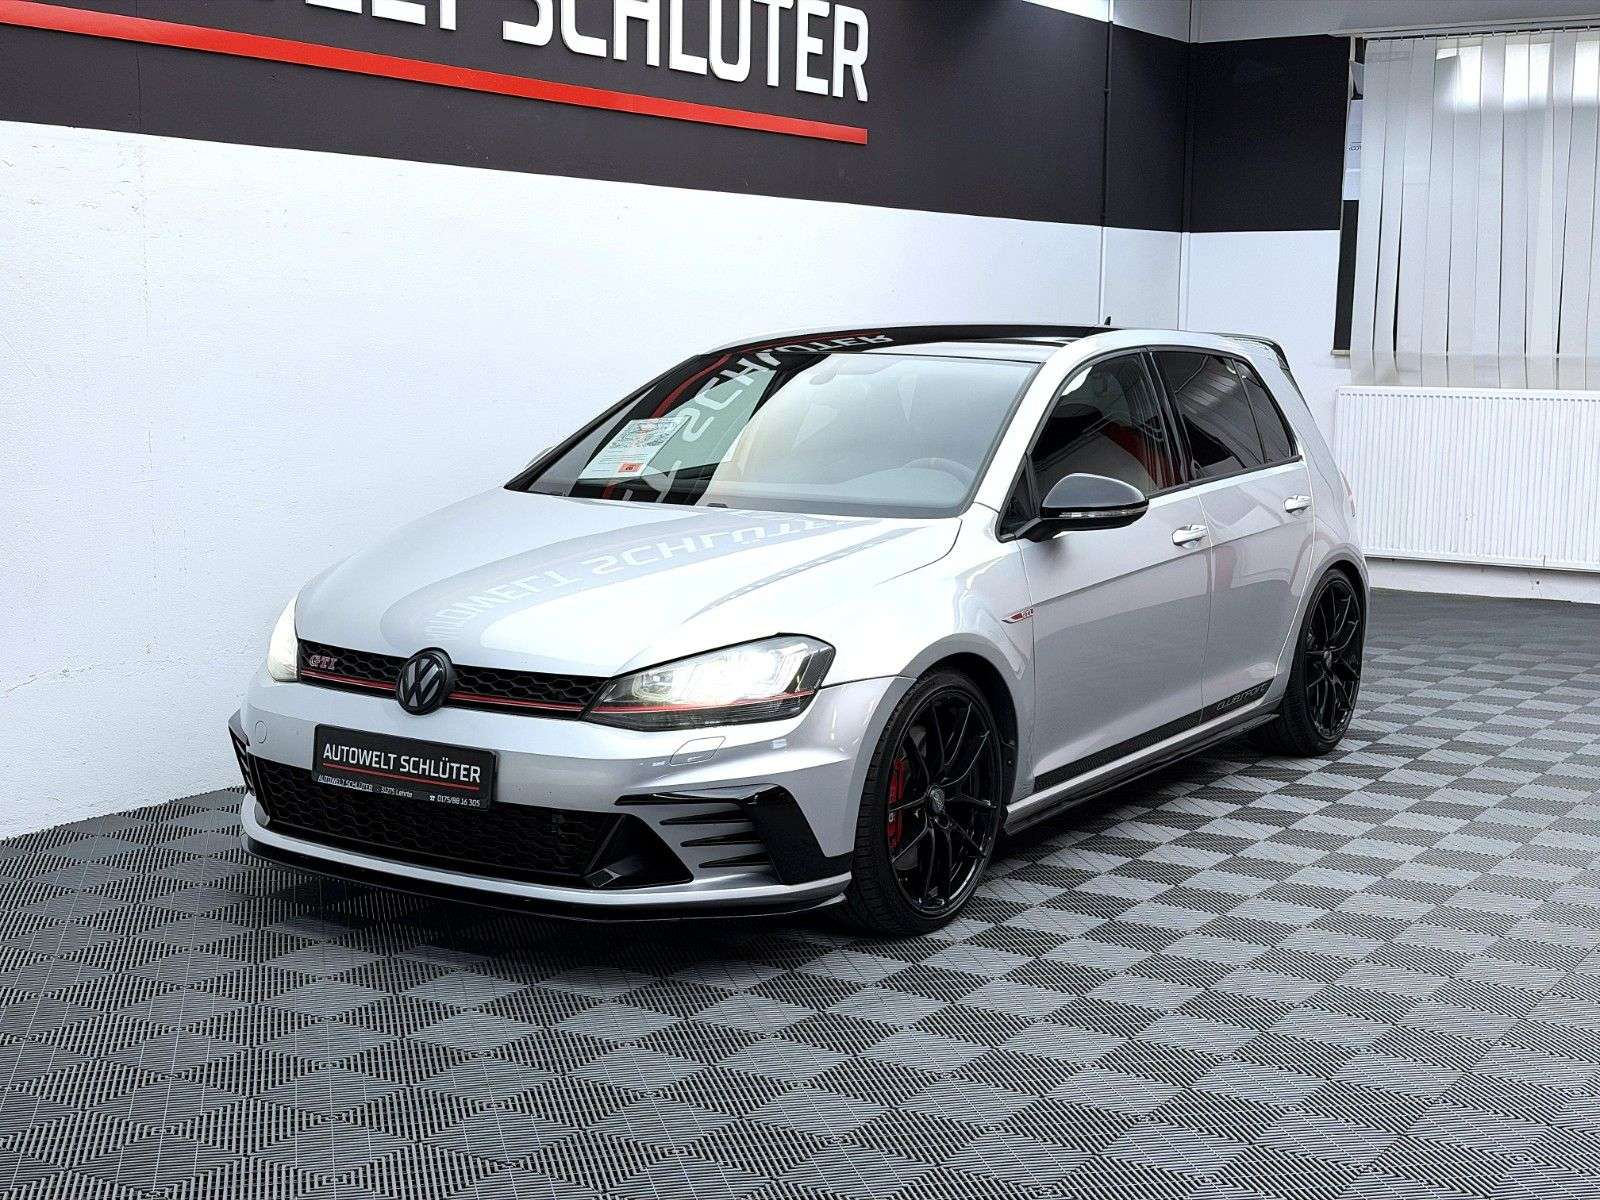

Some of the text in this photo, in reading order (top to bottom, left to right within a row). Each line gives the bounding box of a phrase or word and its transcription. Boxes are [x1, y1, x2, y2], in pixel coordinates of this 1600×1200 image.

[309, 654, 338, 671] GTI
[322, 743, 481, 783] AUTOWELT SCHLÜTER
[317, 774, 345, 787] AUTOWELT
